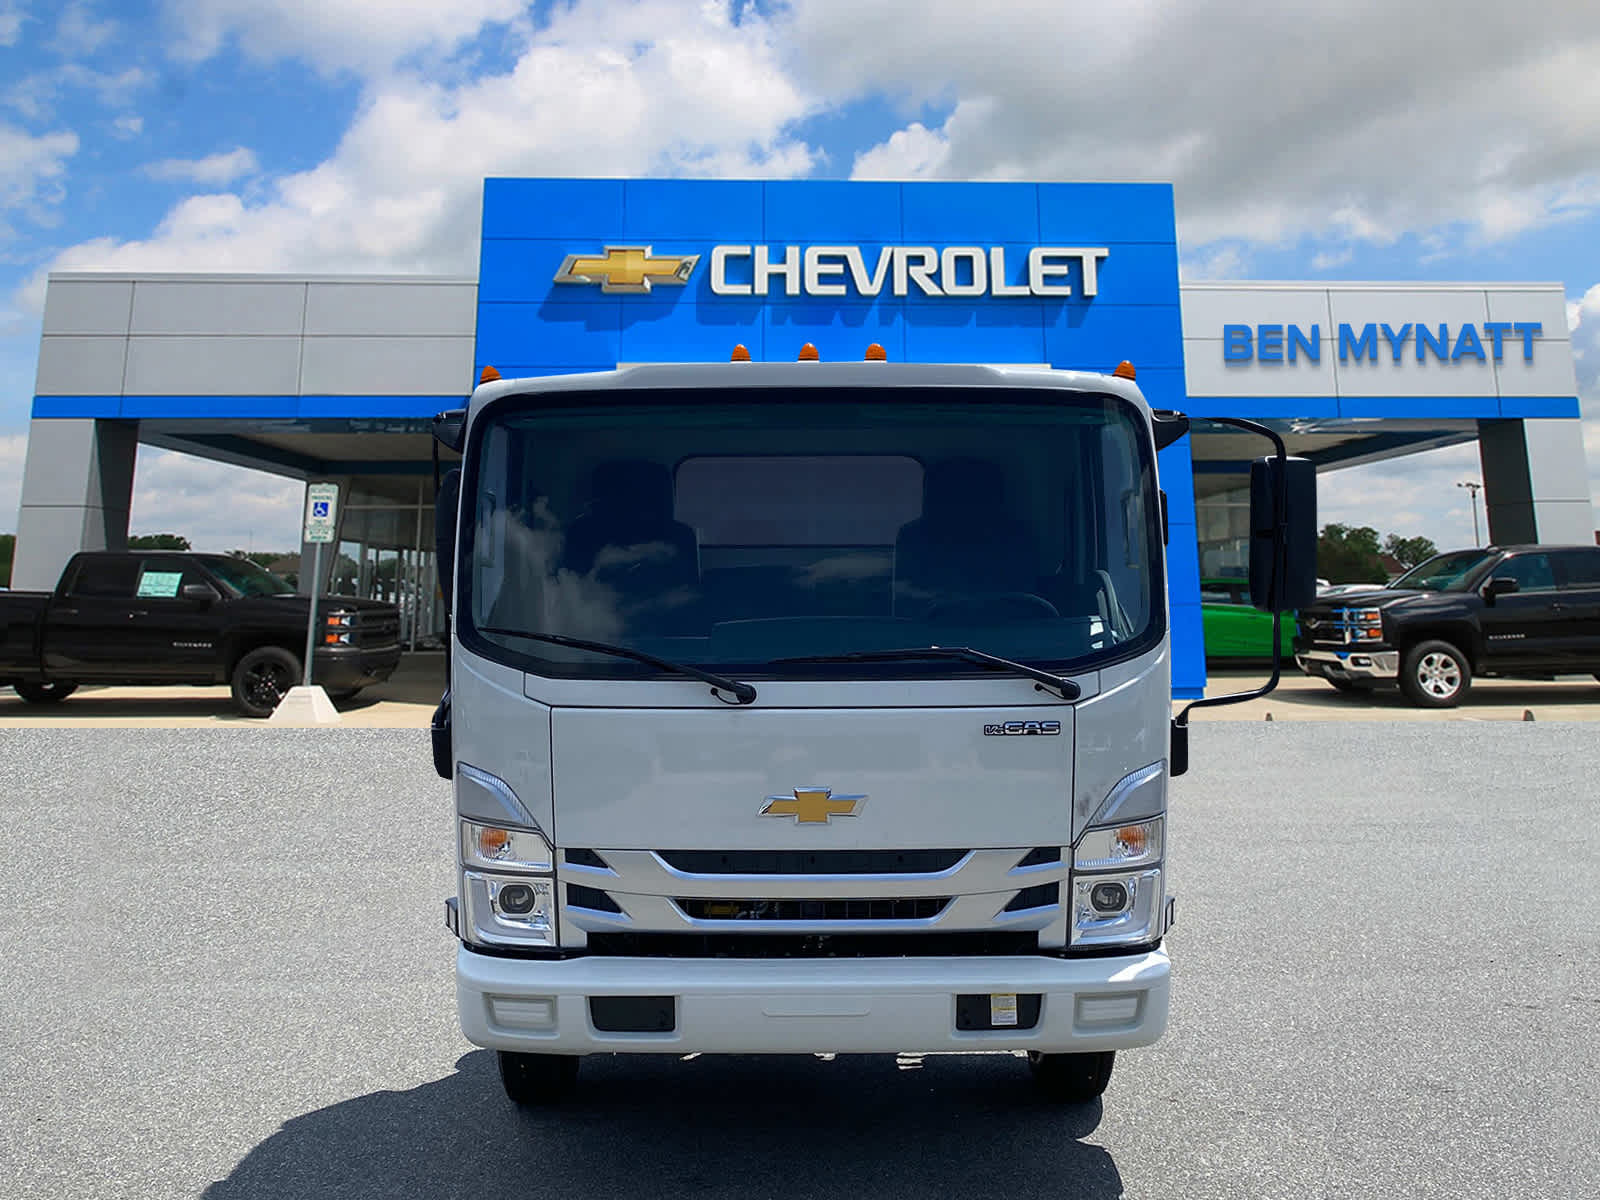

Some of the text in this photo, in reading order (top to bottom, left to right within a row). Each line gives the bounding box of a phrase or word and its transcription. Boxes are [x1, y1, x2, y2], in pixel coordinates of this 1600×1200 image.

[709, 244, 1110, 297] CHEVROLET
[1223, 321, 1543, 363] BEN MYNATT
[1003, 721, 1060, 736] GAS
